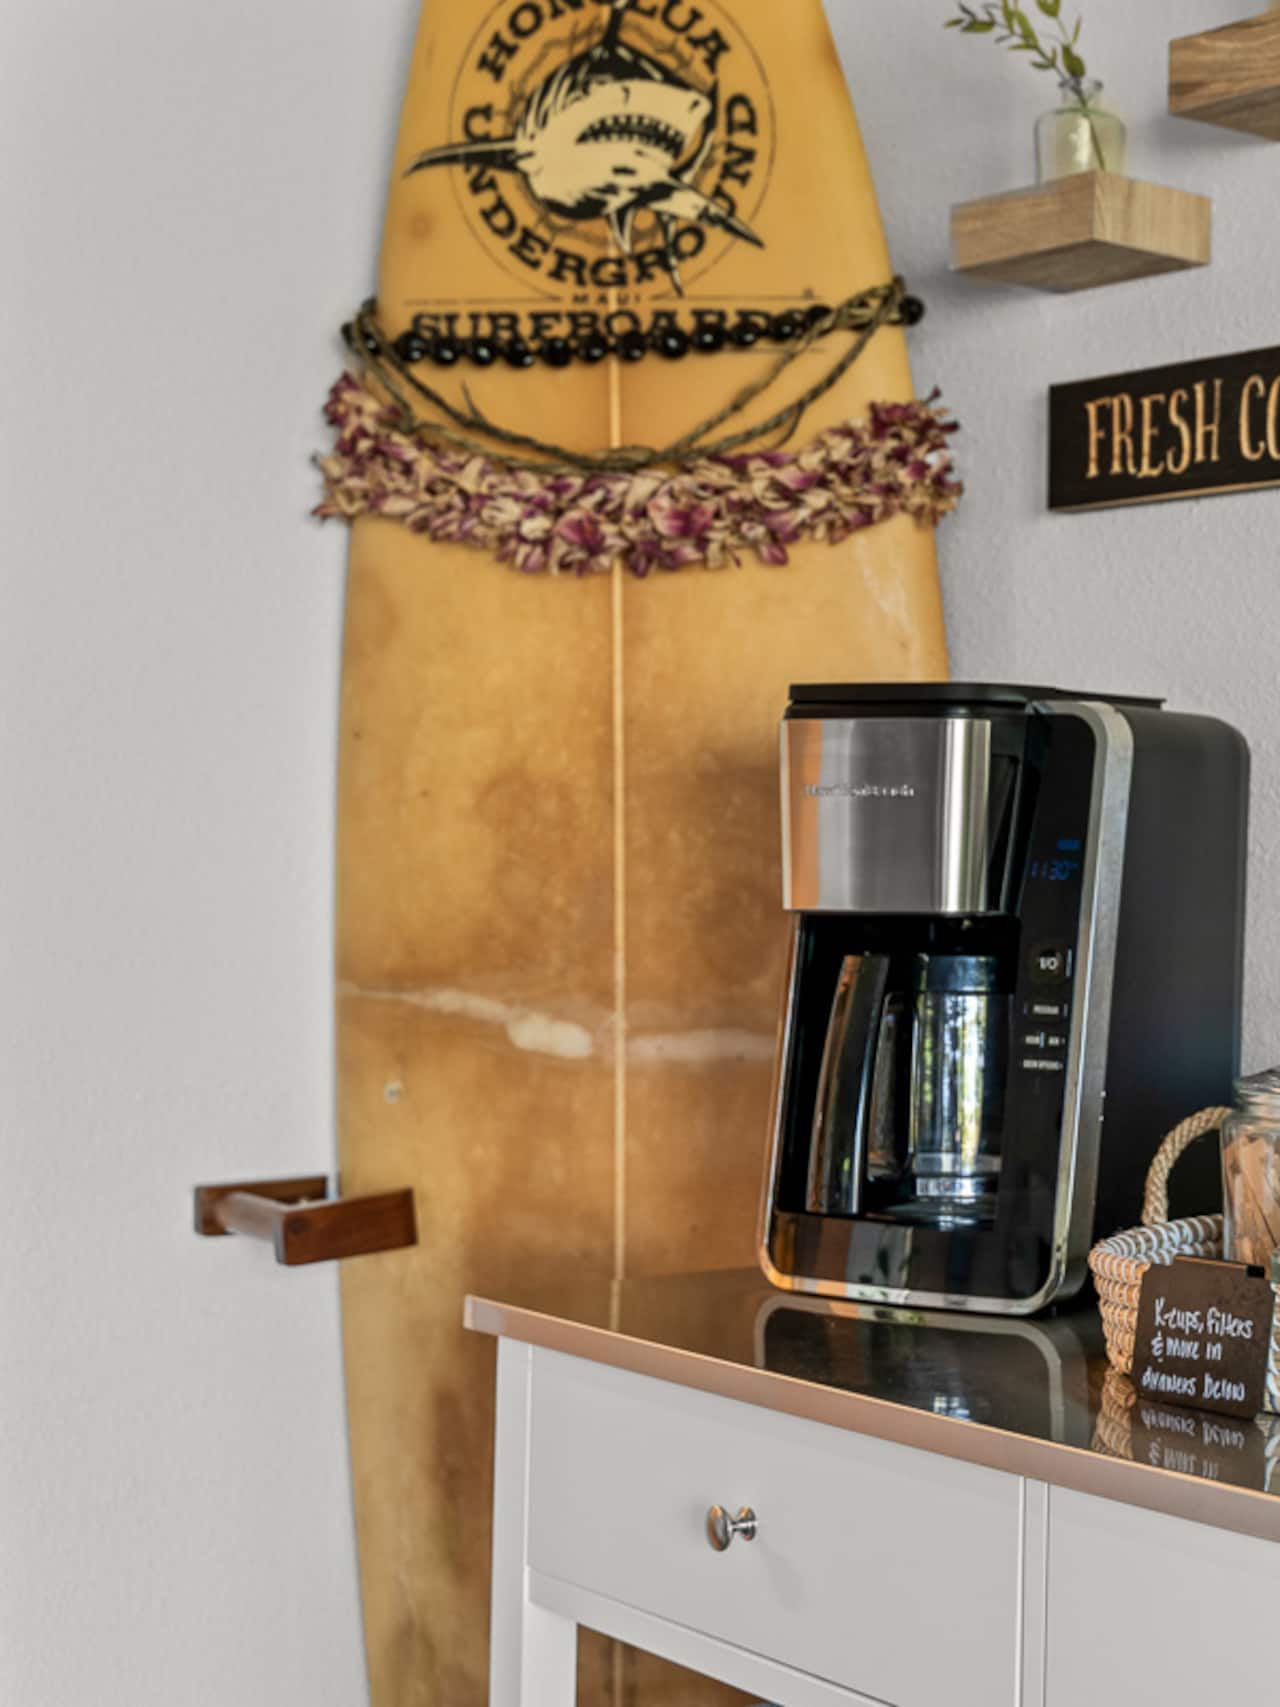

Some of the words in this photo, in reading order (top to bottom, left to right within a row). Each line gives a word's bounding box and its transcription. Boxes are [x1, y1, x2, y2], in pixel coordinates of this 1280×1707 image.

[1085, 378, 1223, 479] FRESH
[1206, 1306, 1254, 1339] filters
[1166, 1336, 1200, 1361] more
[1206, 1342, 1222, 1361] in
[1142, 1366, 1197, 1396] drawers
